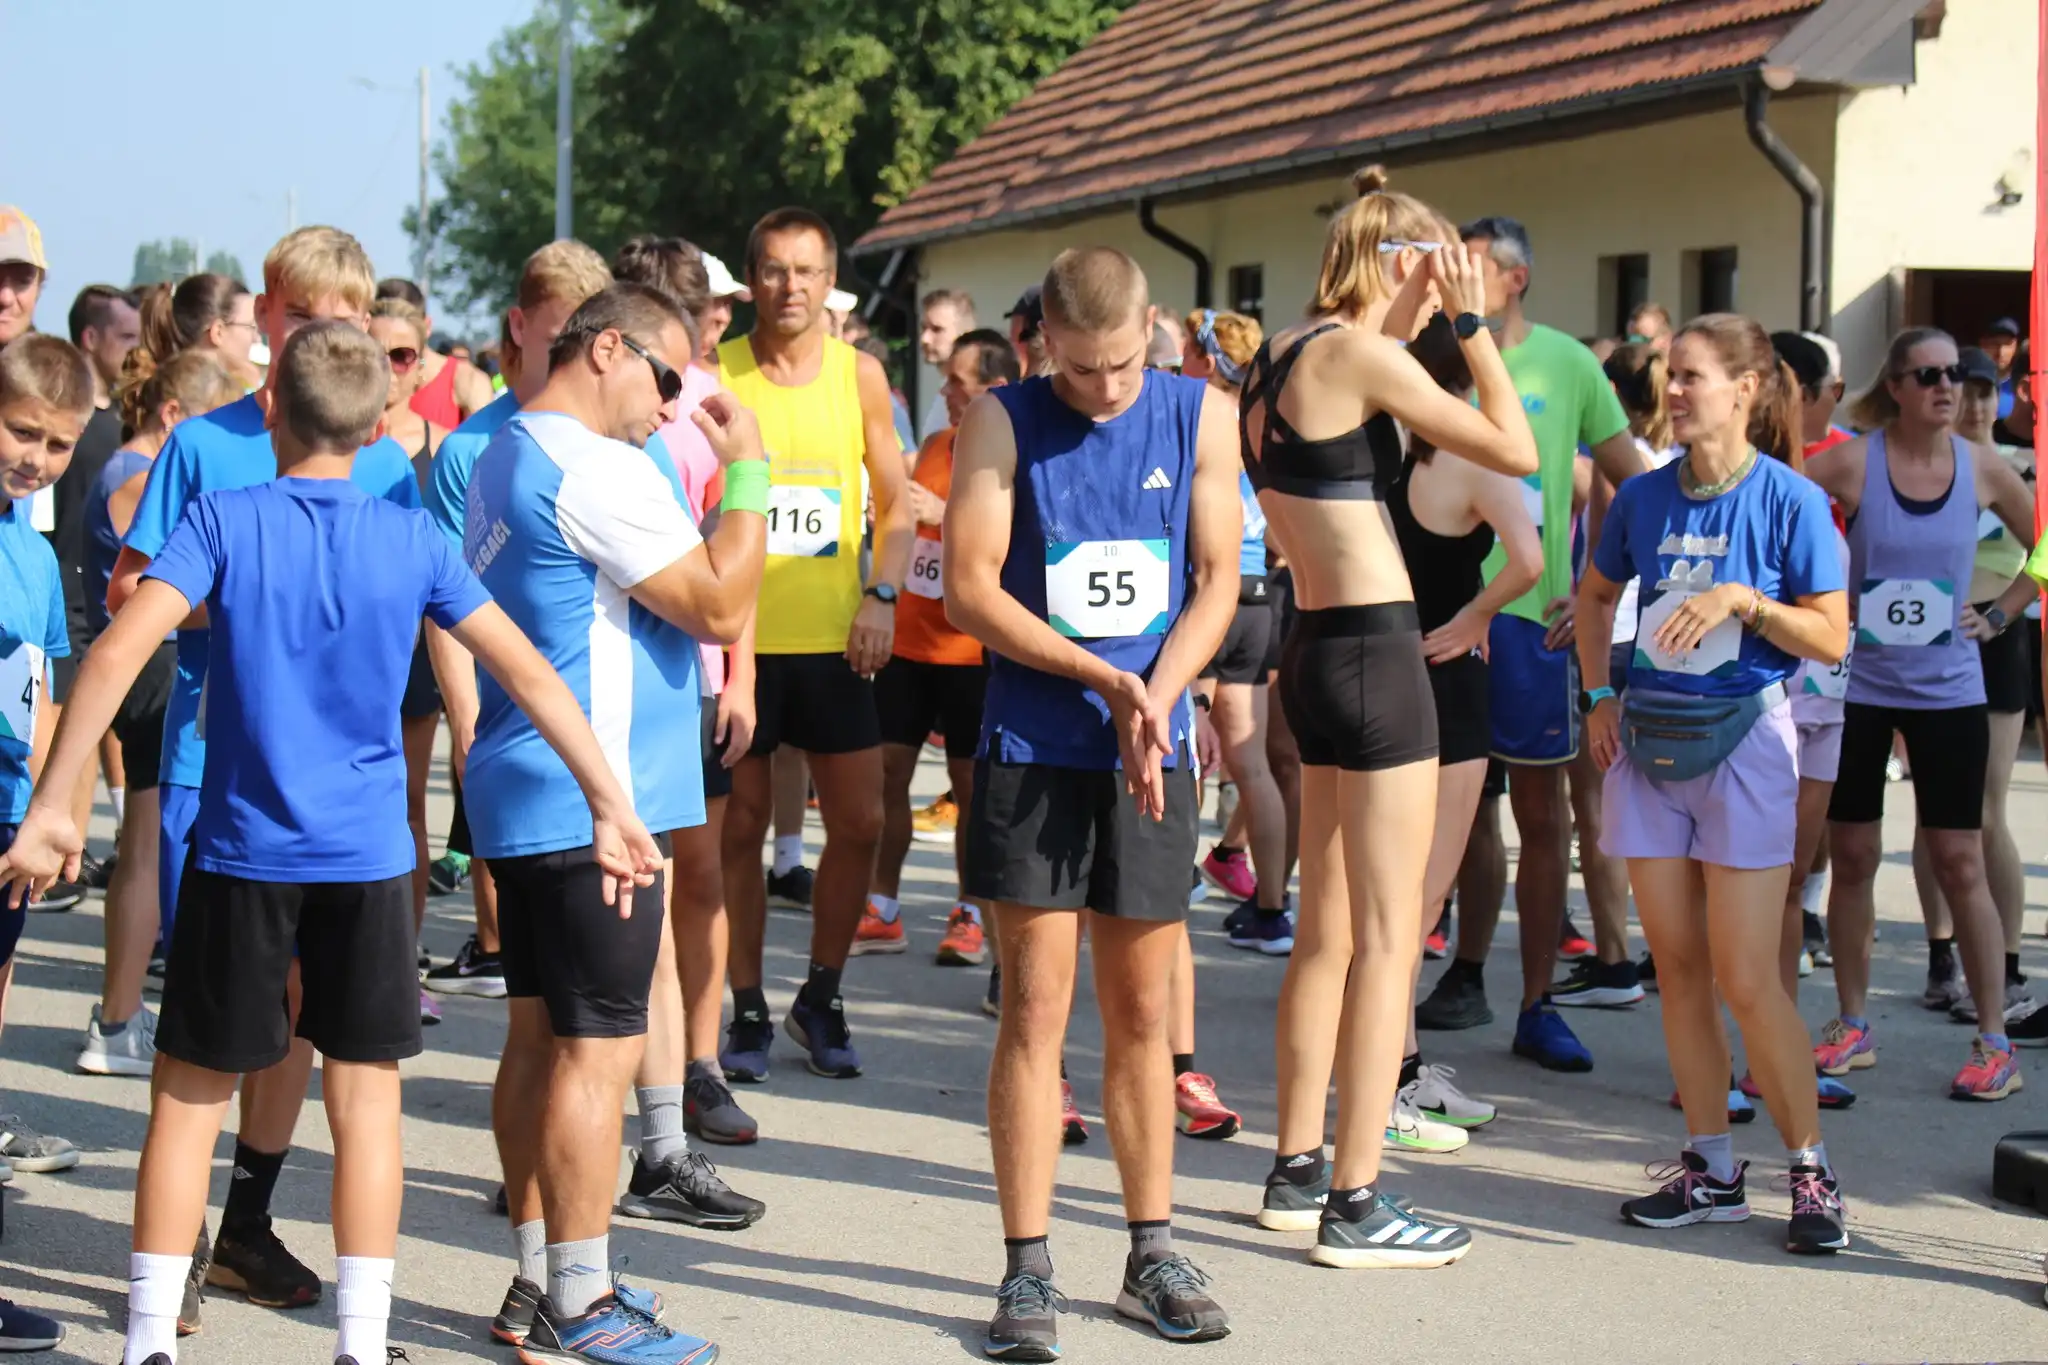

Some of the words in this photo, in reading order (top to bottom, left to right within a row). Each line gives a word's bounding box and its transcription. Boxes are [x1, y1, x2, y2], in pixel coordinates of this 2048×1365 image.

[767, 507, 822, 534] 116
[914, 556, 940, 581] 66
[1088, 570, 1136, 607] 55
[1887, 600, 1925, 625] 63
